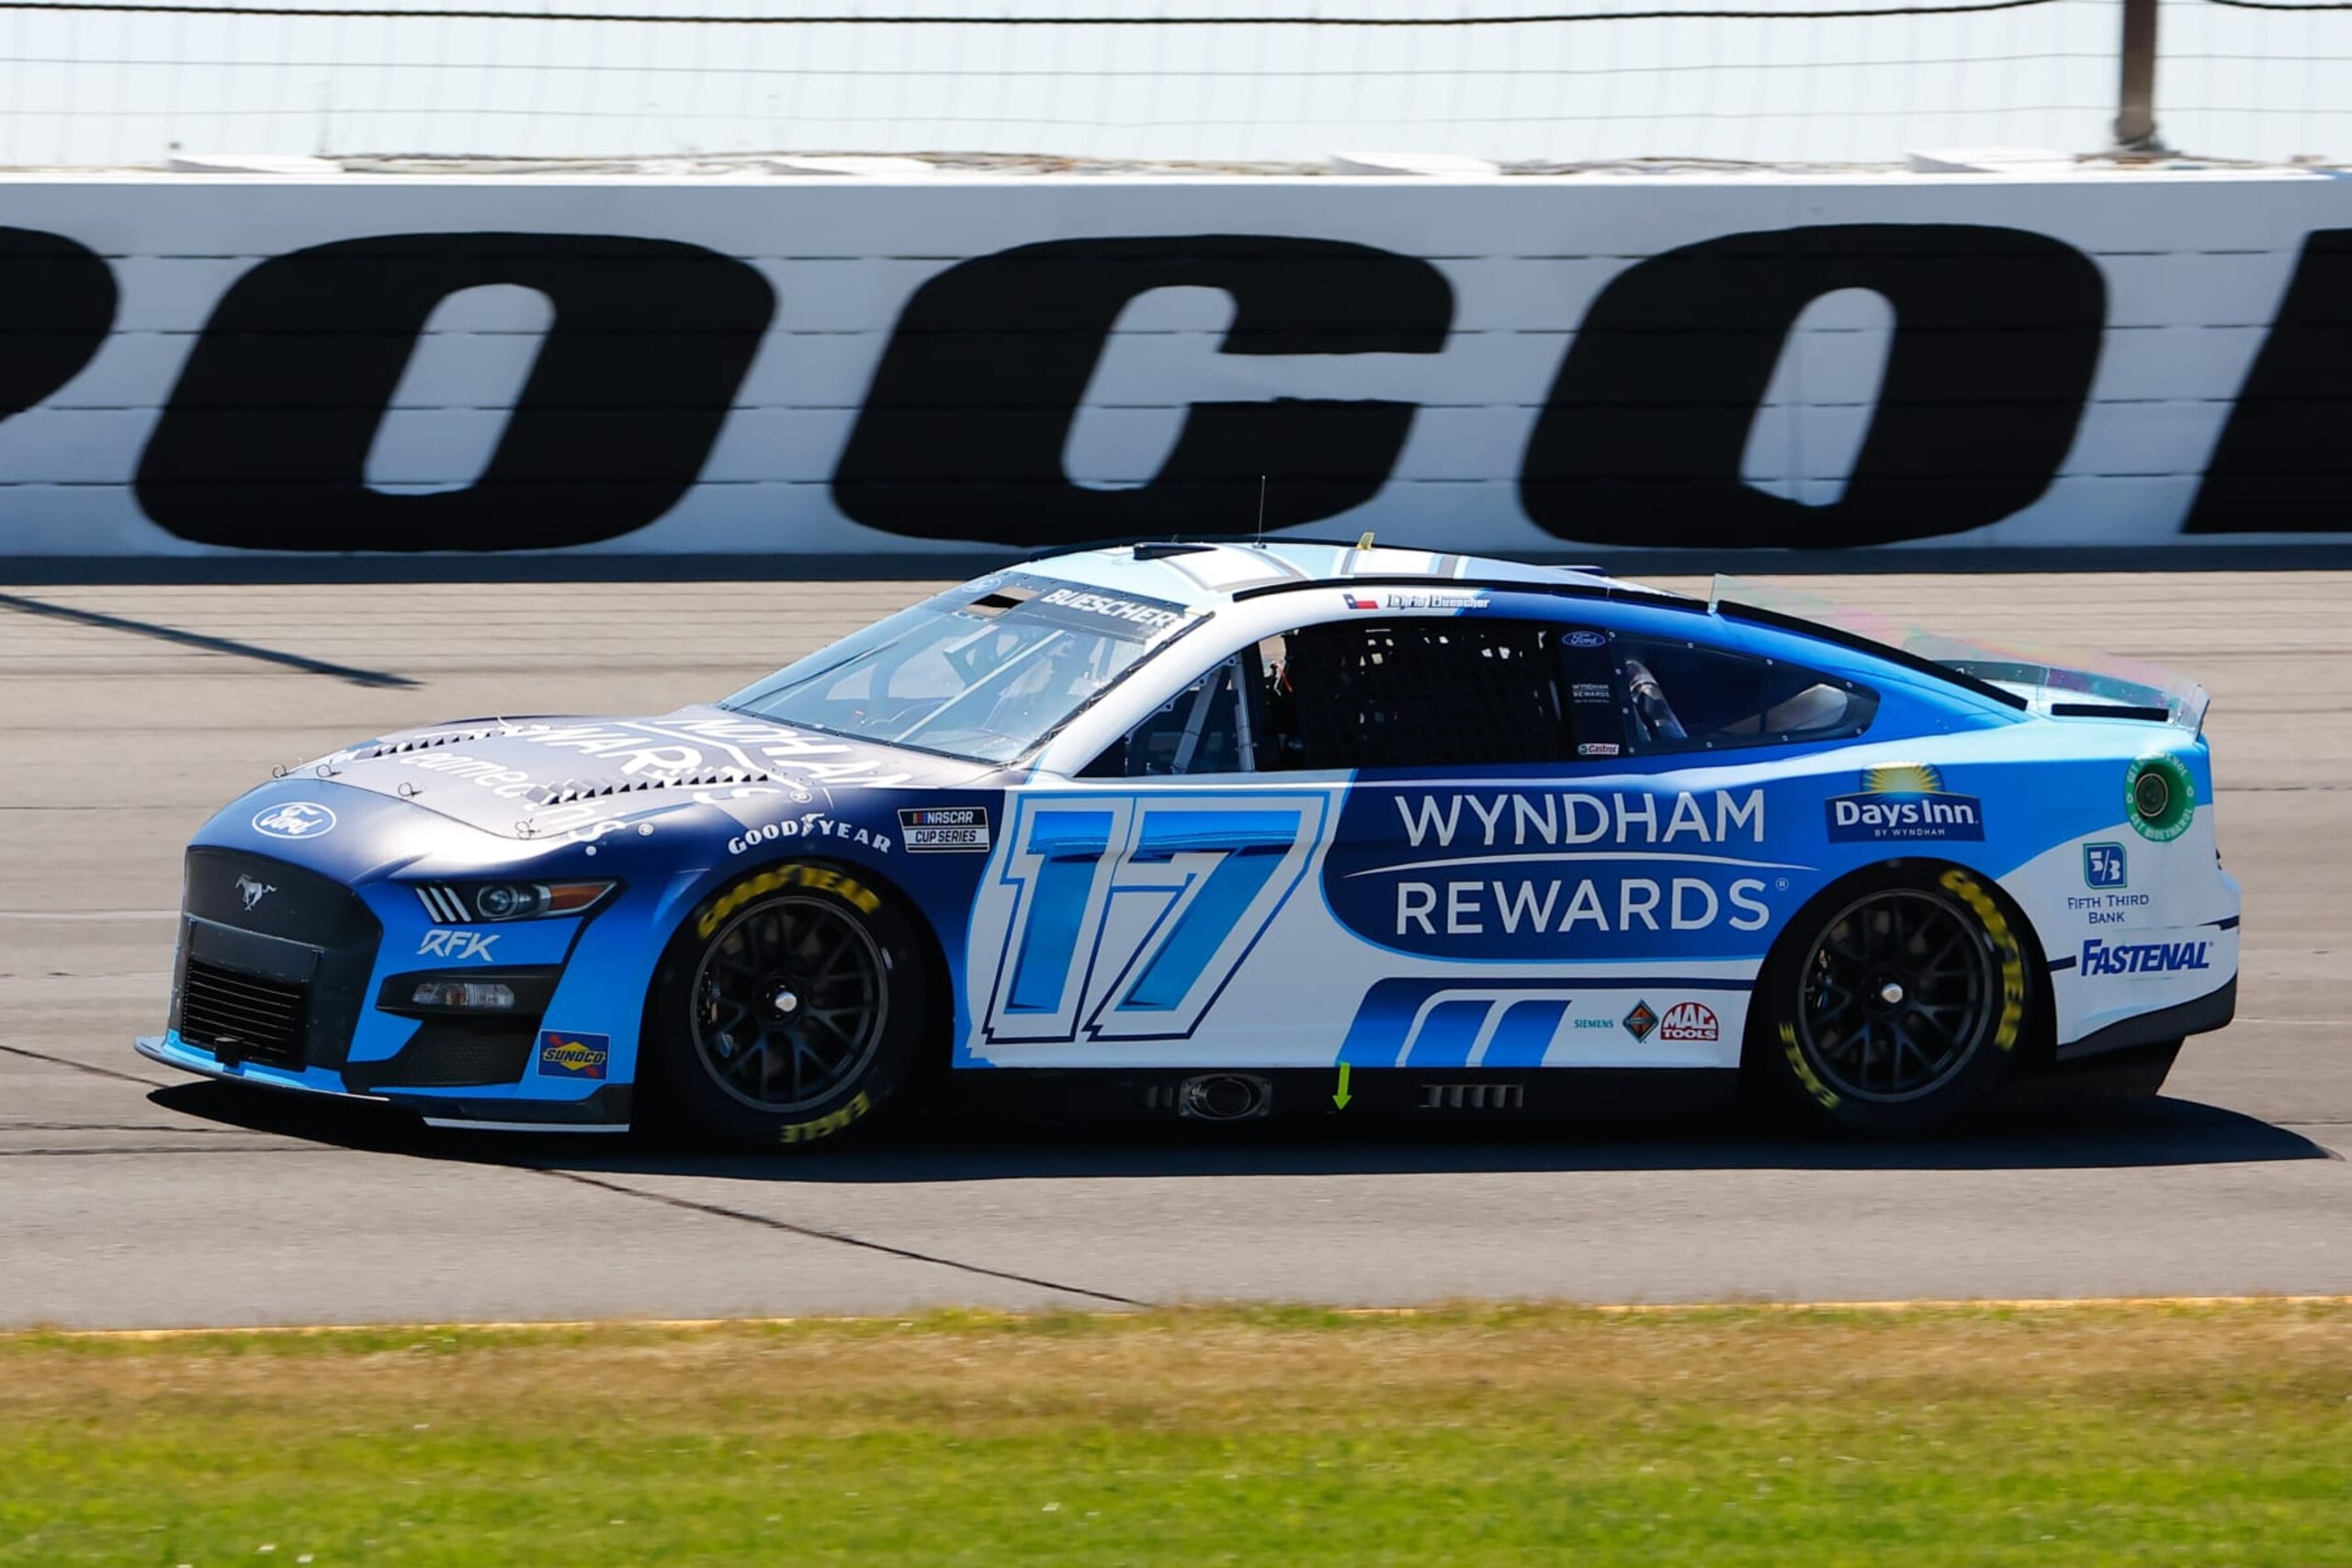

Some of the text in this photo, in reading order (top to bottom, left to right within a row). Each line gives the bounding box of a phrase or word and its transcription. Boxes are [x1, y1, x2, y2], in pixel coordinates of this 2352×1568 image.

[0, 227, 2352, 551] OCO
[1040, 589, 1179, 628] BUESCHER
[1570, 634, 1598, 644] Ford
[1588, 744, 1617, 753] Castrol
[260, 805, 322, 834] Ford
[927, 811, 974, 824] NASCAR
[1395, 789, 1764, 846] WYNDHAM
[1836, 799, 1974, 827] Days Inn
[728, 813, 891, 854] GOODYEAR
[915, 829, 978, 842] CUP SERIES
[1874, 829, 1887, 837] BY
[2067, 895, 2149, 909] FIFTH THIRD
[981, 790, 1330, 1044] 17
[2088, 912, 2125, 924] BANK
[416, 929, 501, 962] RFK
[2081, 939, 2210, 976] FASTENAL
[1574, 1019, 1614, 1028] SIEMENS
[1662, 1003, 1715, 1029] MAC
[1664, 1029, 1716, 1039] TOOLS
[544, 1048, 606, 1065] SUNOCO
